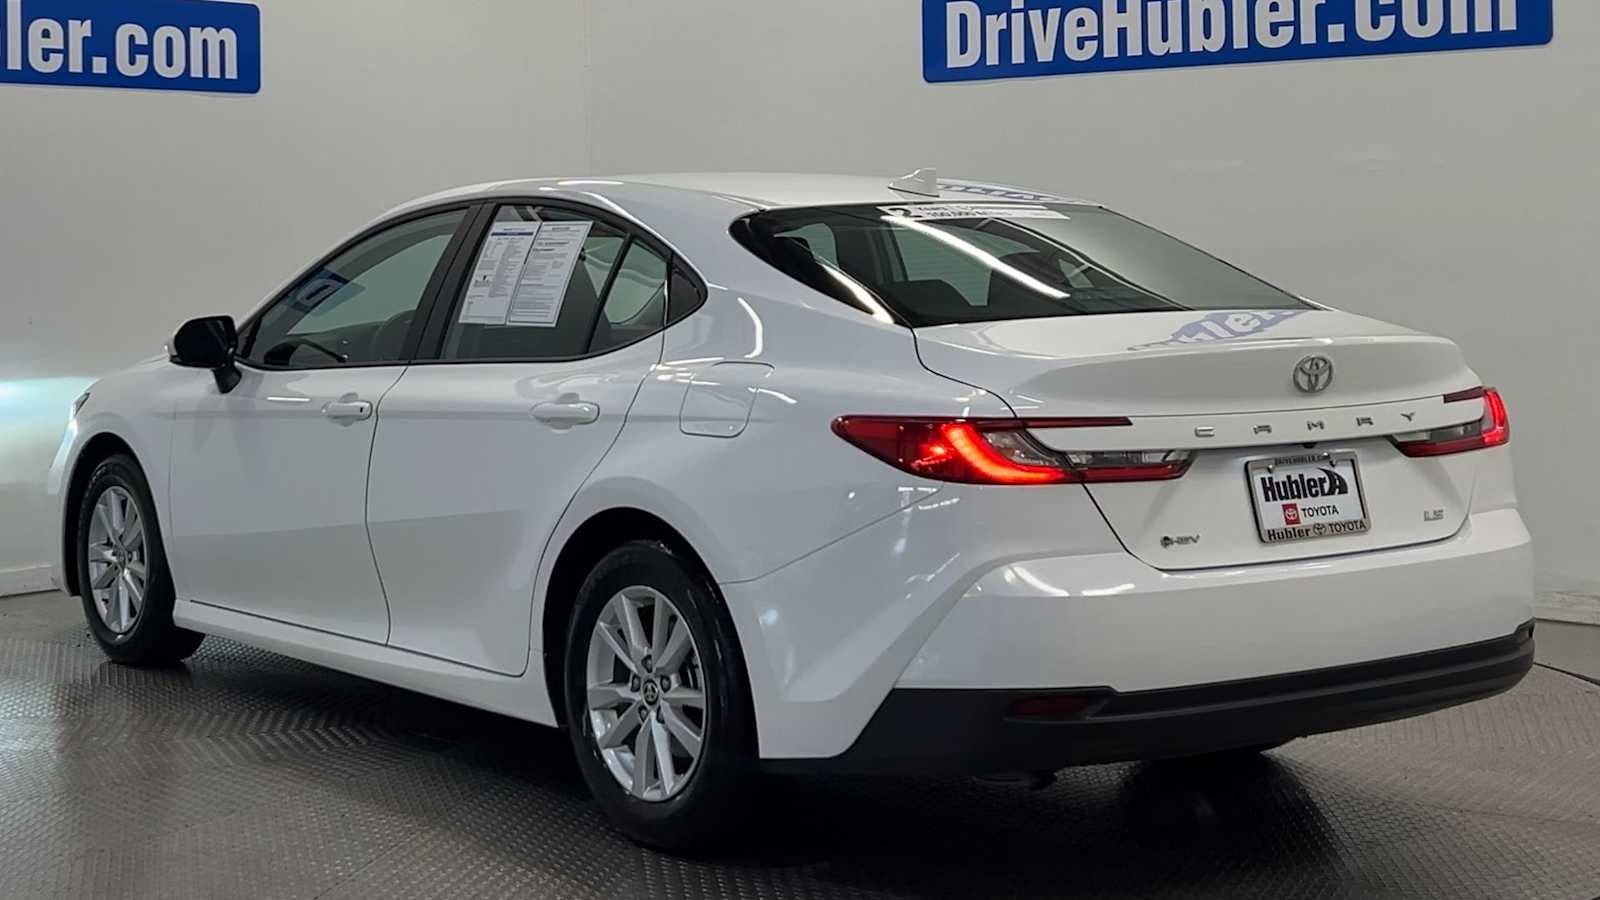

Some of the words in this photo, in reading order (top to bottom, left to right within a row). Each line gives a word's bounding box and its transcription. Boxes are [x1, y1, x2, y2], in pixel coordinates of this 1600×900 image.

[945, 0, 1518, 69] DriveHubler.com
[1194, 411, 1417, 439] CAMRY
[1260, 473, 1328, 502] Hubler
[1301, 504, 1340, 519] TOYOTA
[1267, 526, 1312, 541] Hubler
[1327, 519, 1367, 535] TOYOTA
